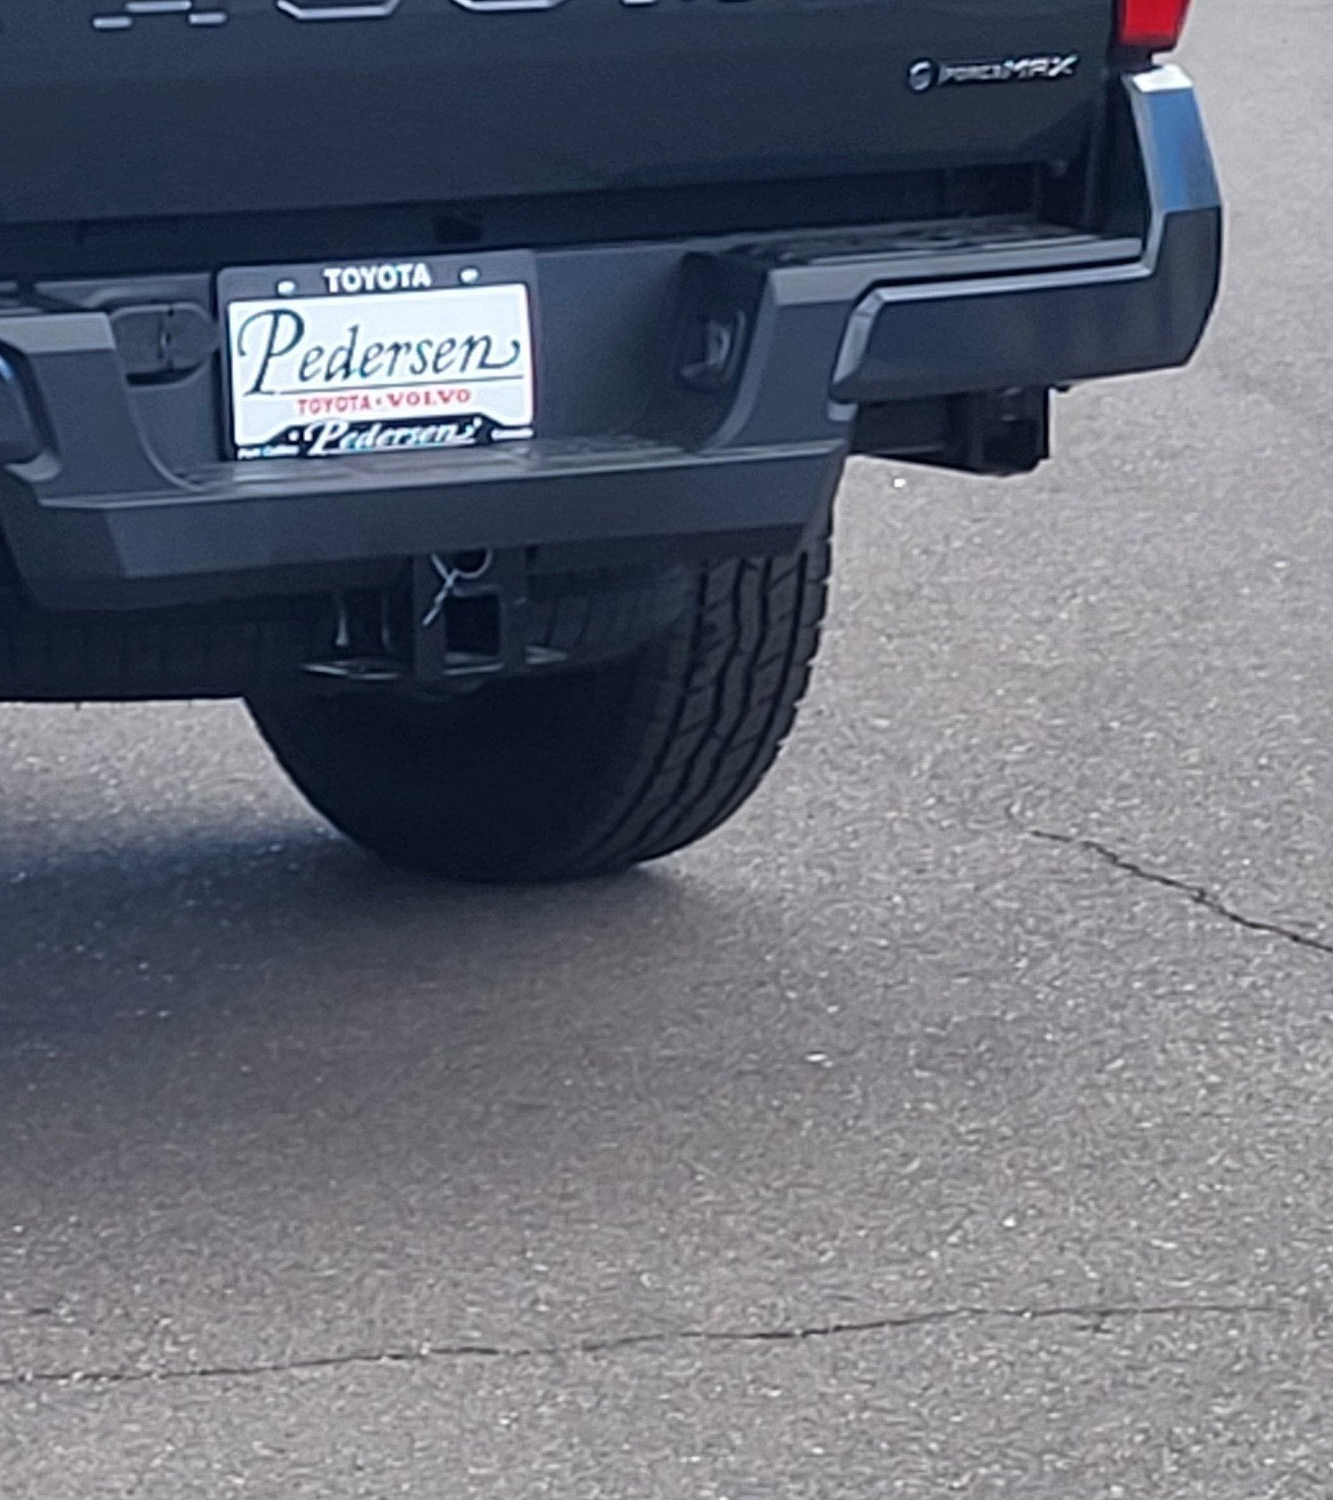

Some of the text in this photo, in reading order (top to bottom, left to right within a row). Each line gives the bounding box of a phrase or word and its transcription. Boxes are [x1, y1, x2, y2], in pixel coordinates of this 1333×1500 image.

[323, 262, 432, 293] TOYOTA
[237, 307, 521, 398] Pedersen
[297, 388, 472, 416] TOYOTA VOLVO
[304, 418, 482, 456] Pedersen
